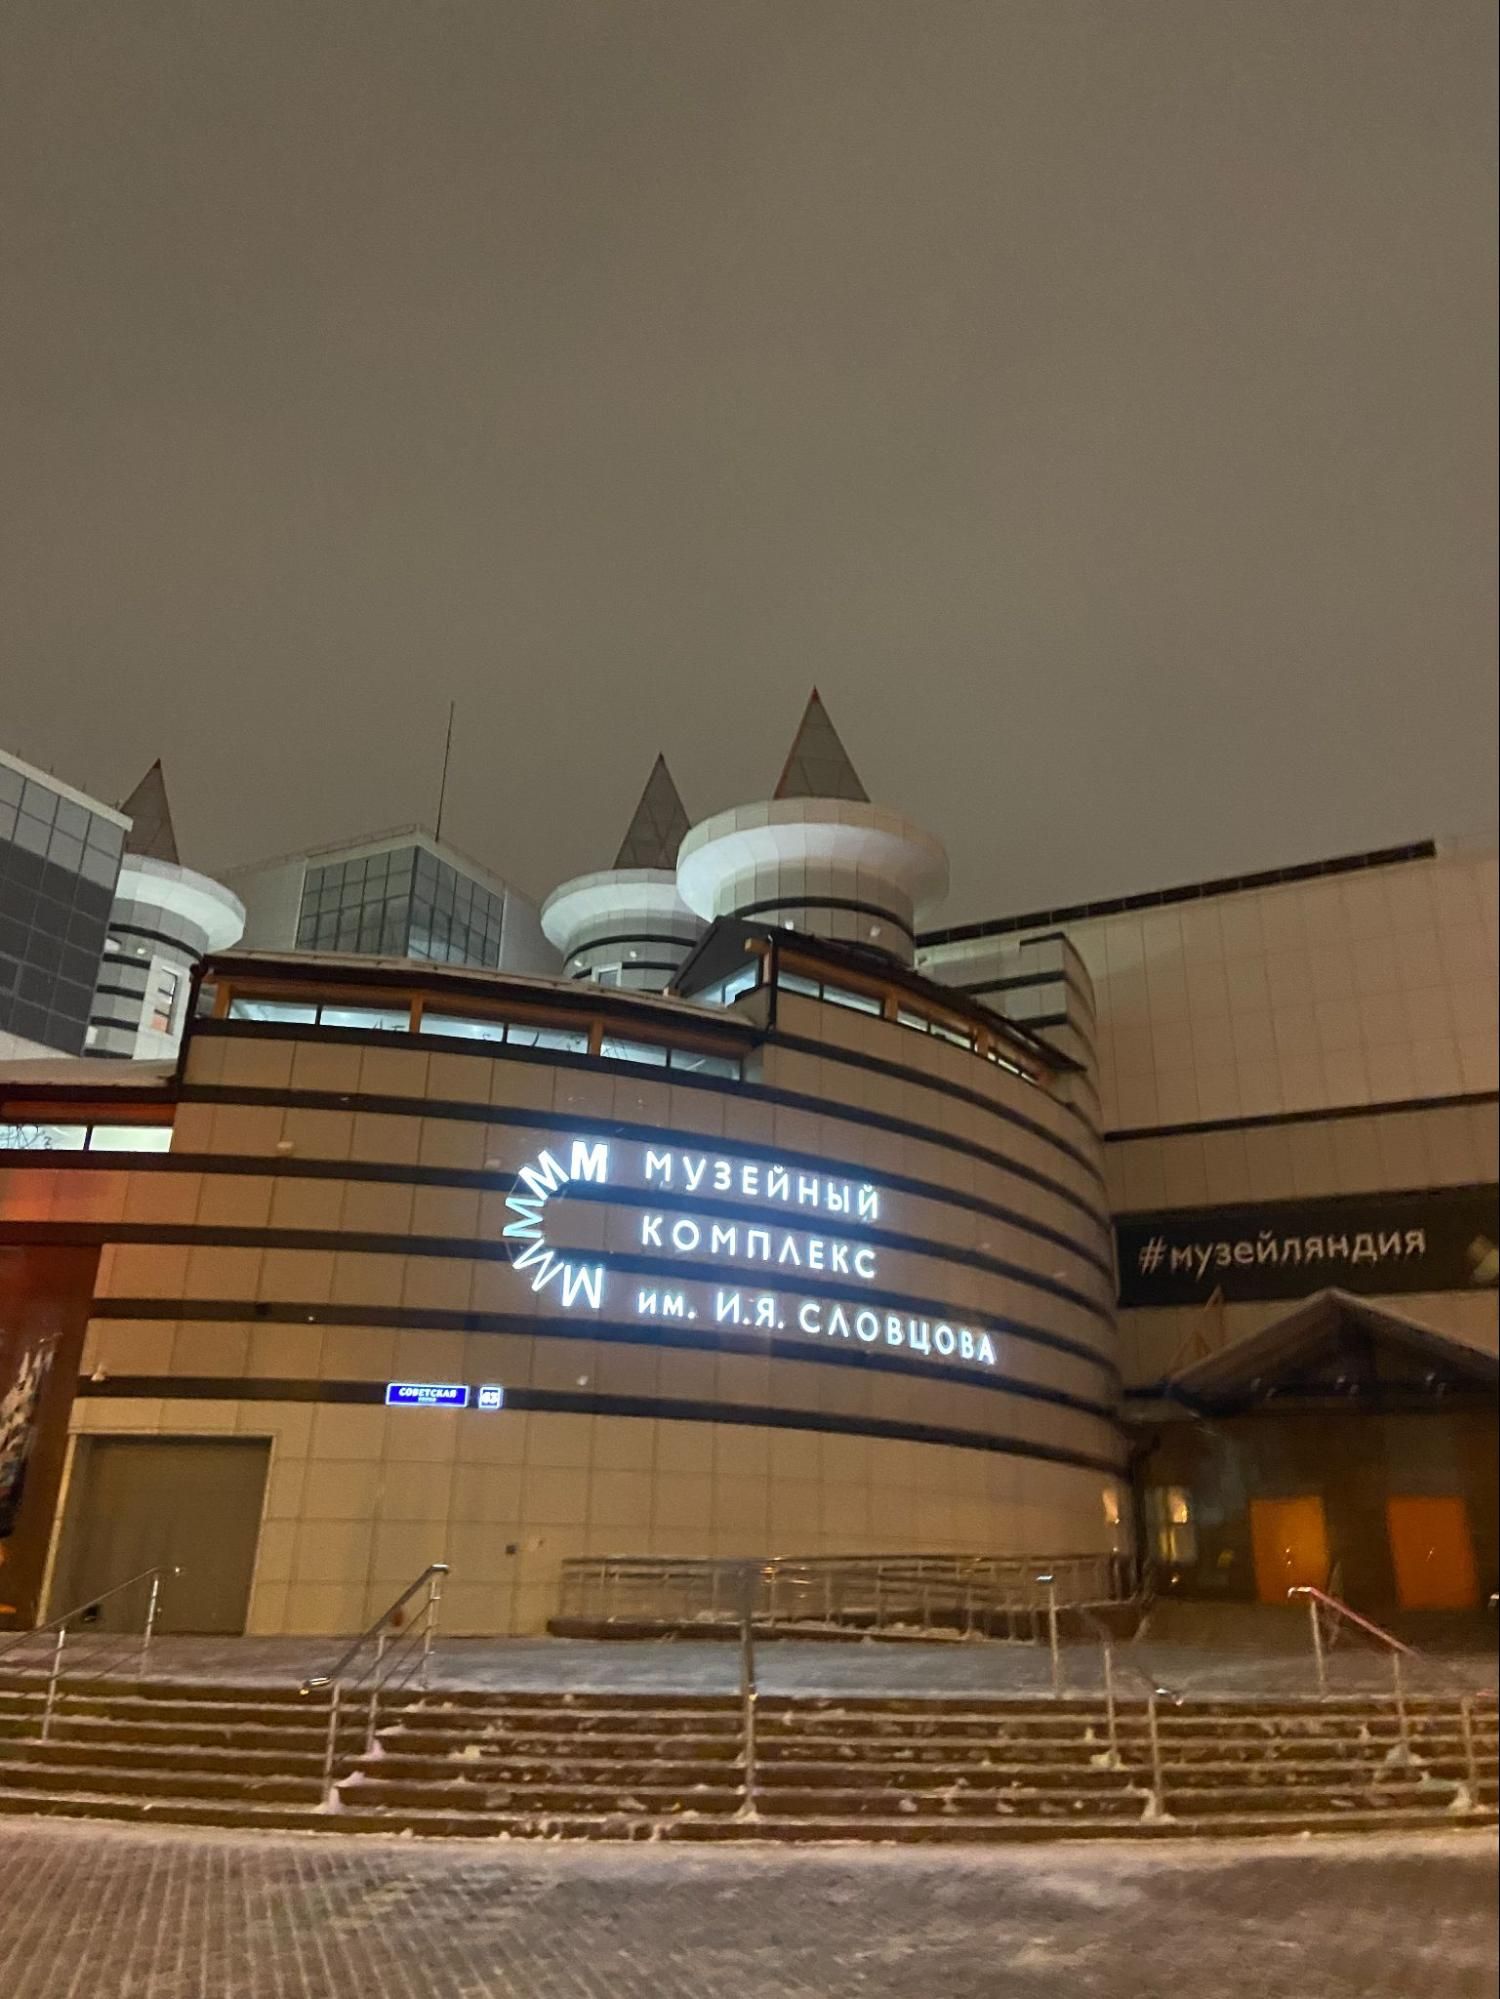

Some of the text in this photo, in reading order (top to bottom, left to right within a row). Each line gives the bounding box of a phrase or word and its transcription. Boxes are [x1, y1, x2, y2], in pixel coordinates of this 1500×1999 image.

[645, 1149, 880, 1220] МУЗЕЙНЫЙ
[641, 1215, 877, 1280] КОМПЛЕКС
[1139, 1229, 1426, 1280] #музейляндия
[637, 1291, 697, 1320] им.
[799, 1303, 997, 1365] СЛОВЦОВА
[399, 1387, 457, 1398] СОВЕТСКАЯ
